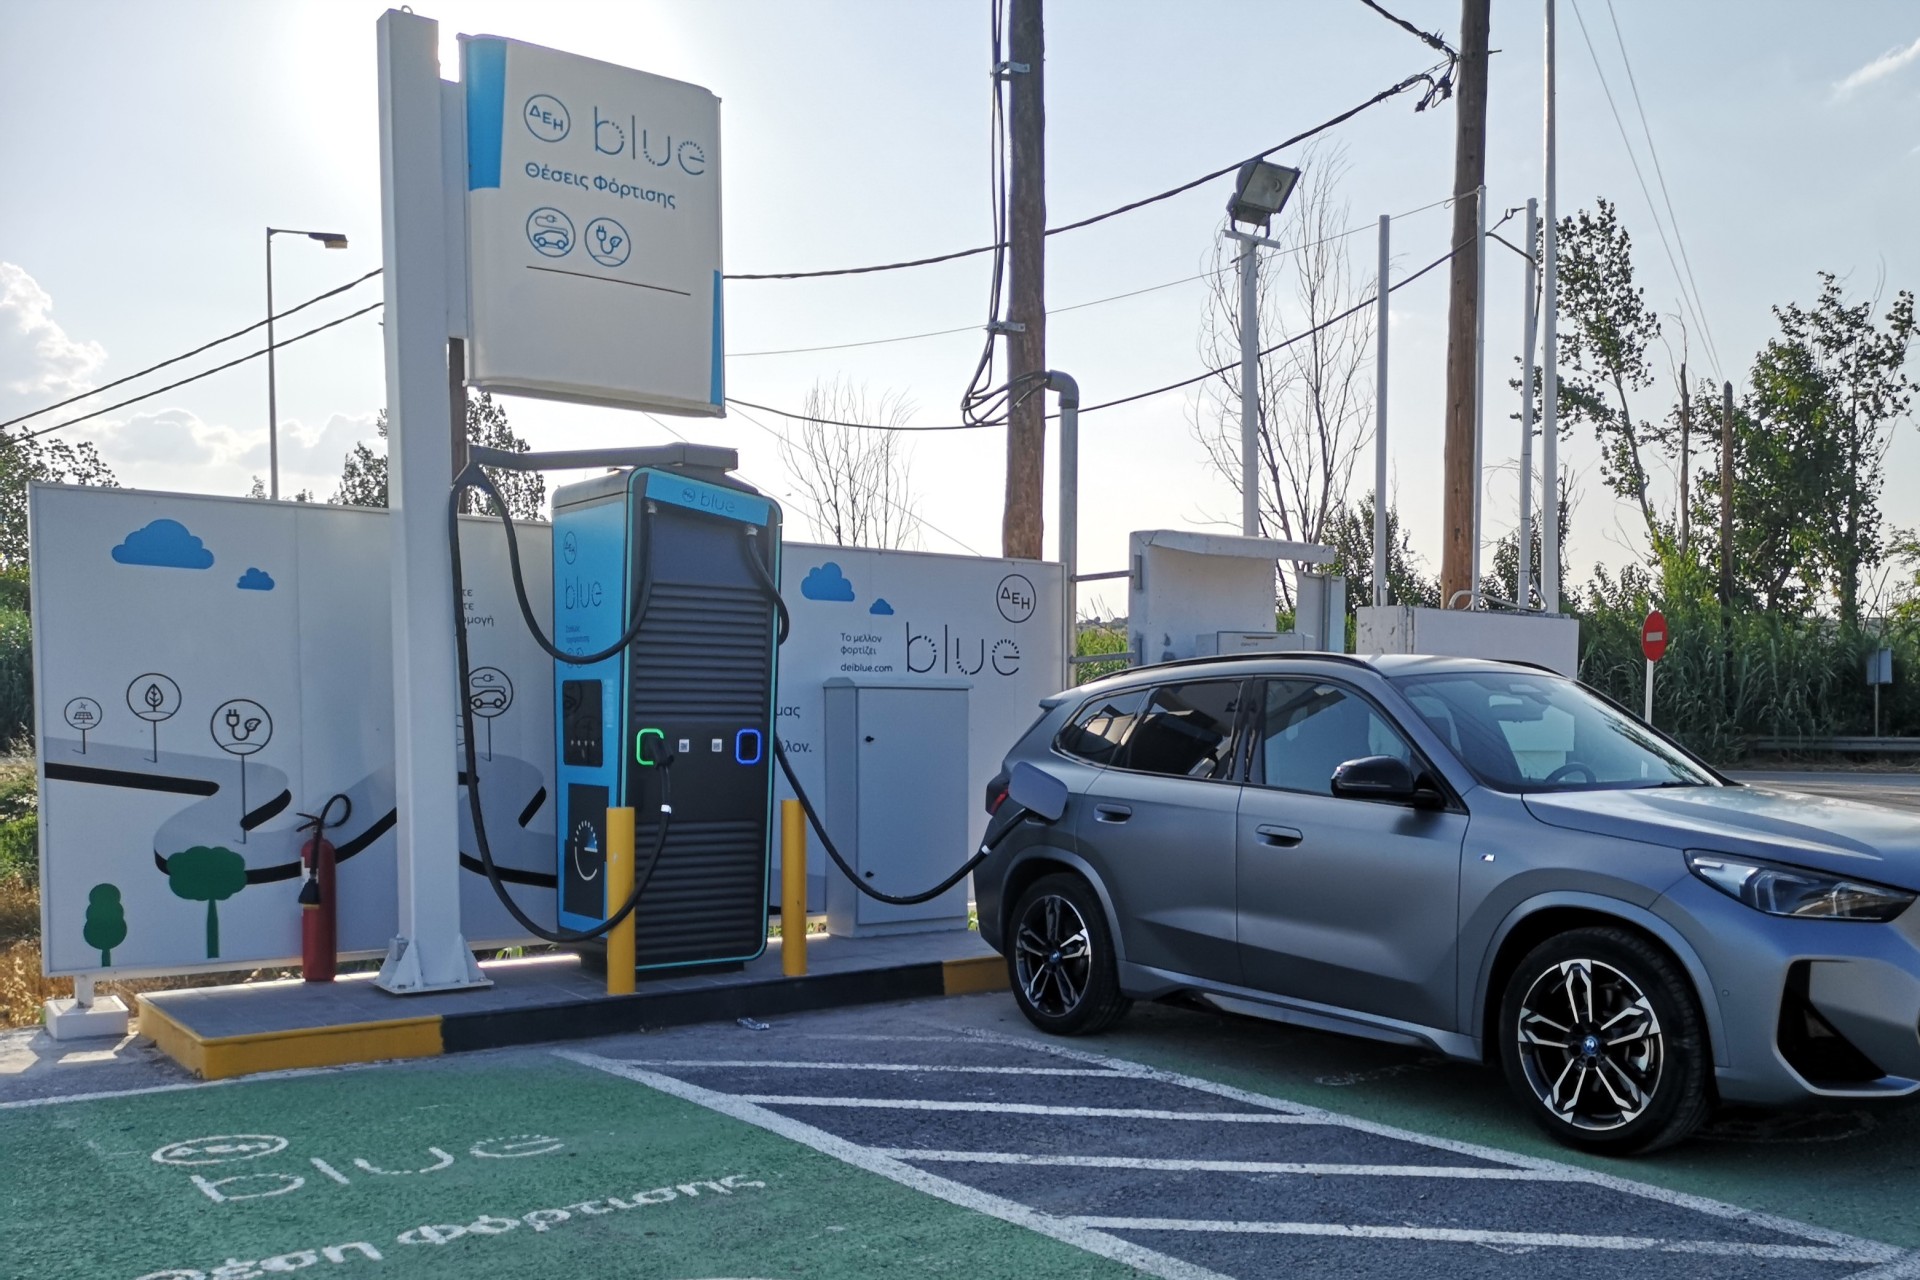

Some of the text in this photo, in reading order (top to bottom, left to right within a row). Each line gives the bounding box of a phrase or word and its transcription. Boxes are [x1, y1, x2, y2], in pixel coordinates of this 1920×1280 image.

[529, 104, 564, 131] ΔΕΗ
[594, 106, 705, 176] blue
[525, 162, 676, 210] Θέσεις Φόρτισης
[700, 490, 736, 513] blue
[565, 575, 603, 610] blue
[1000, 586, 1030, 610] ΔΕΗ
[906, 621, 1020, 676] blue
[840, 662, 893, 673] deiblue.com
[189, 1134, 565, 1203] blue
